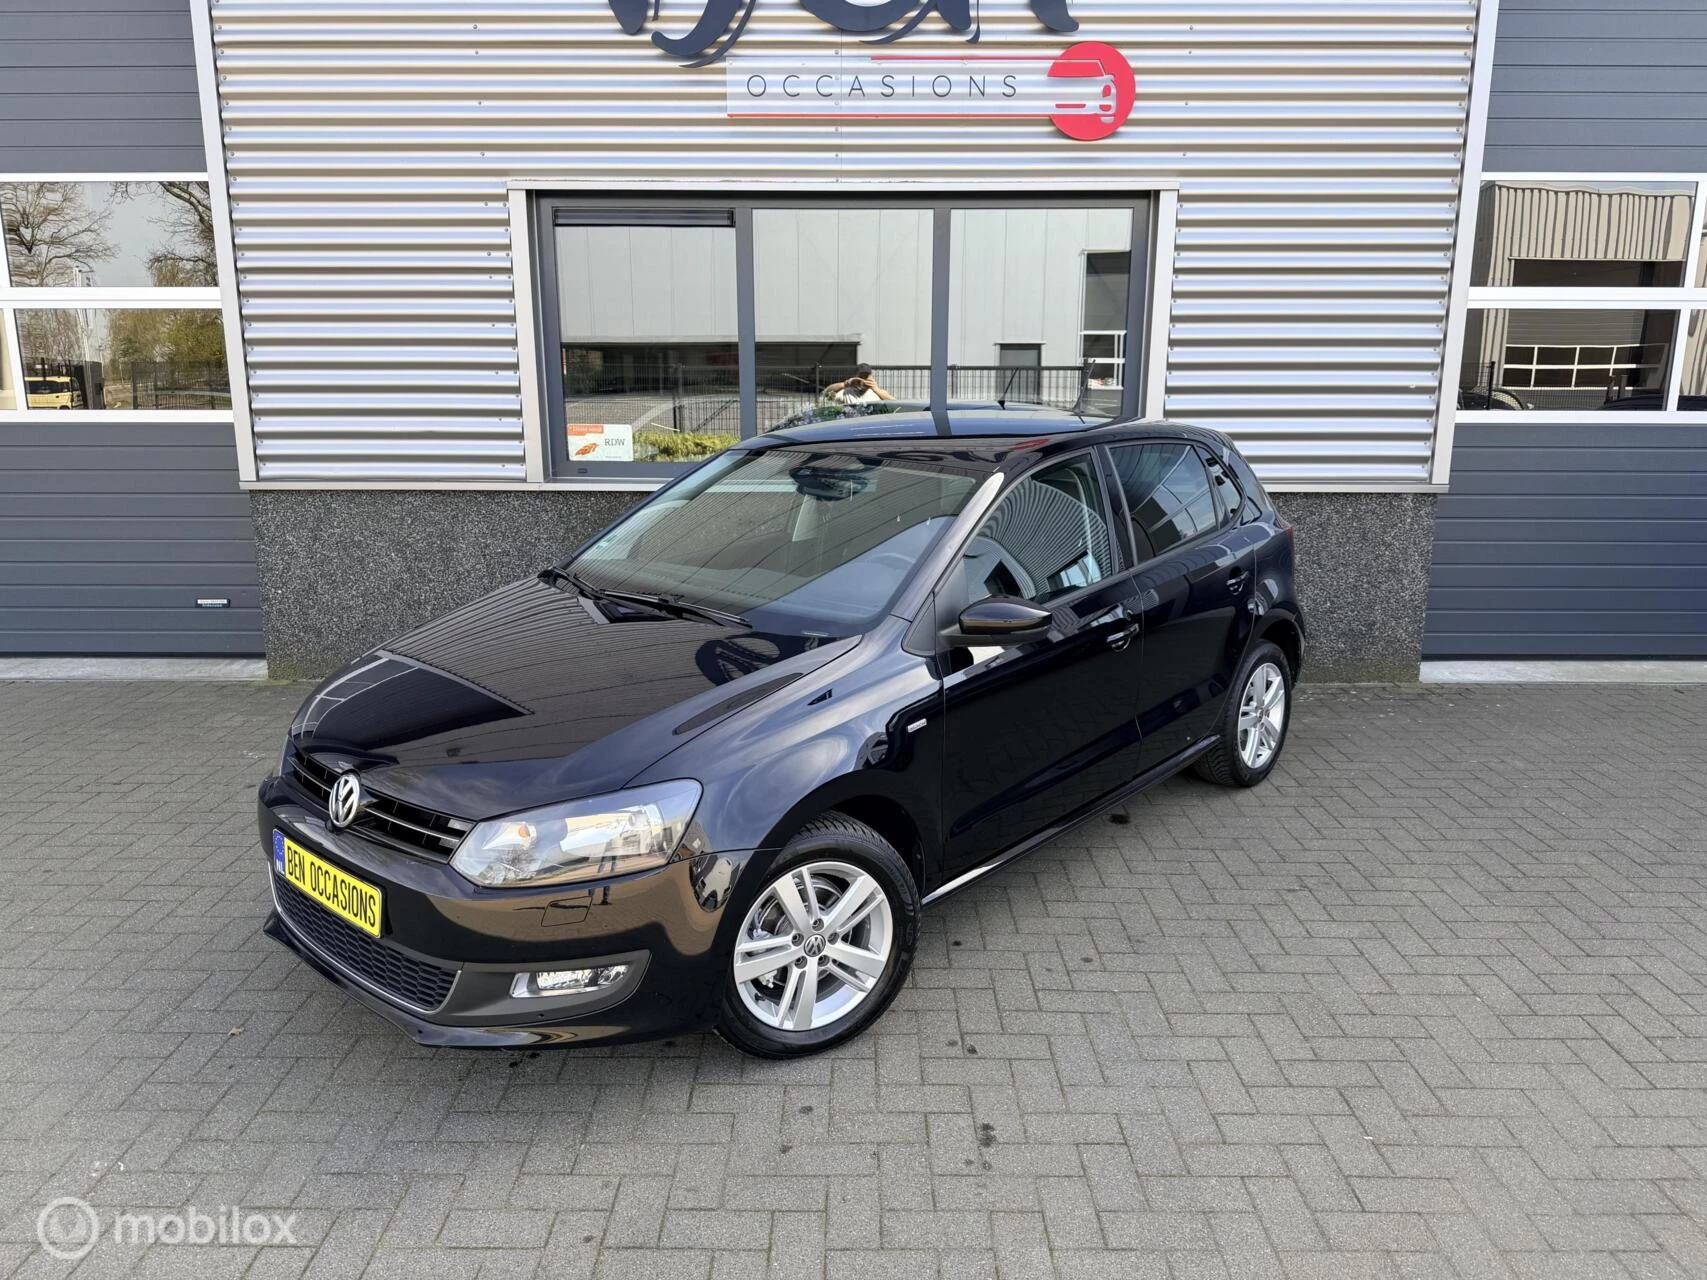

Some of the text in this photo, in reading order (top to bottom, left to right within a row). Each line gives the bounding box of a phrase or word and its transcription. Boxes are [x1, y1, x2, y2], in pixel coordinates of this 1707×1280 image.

[746, 74, 1017, 98] OCCASIONS
[604, 438, 626, 447] RDW
[276, 858, 285, 875] NL
[287, 845, 377, 928] BEN OCCASIONS
